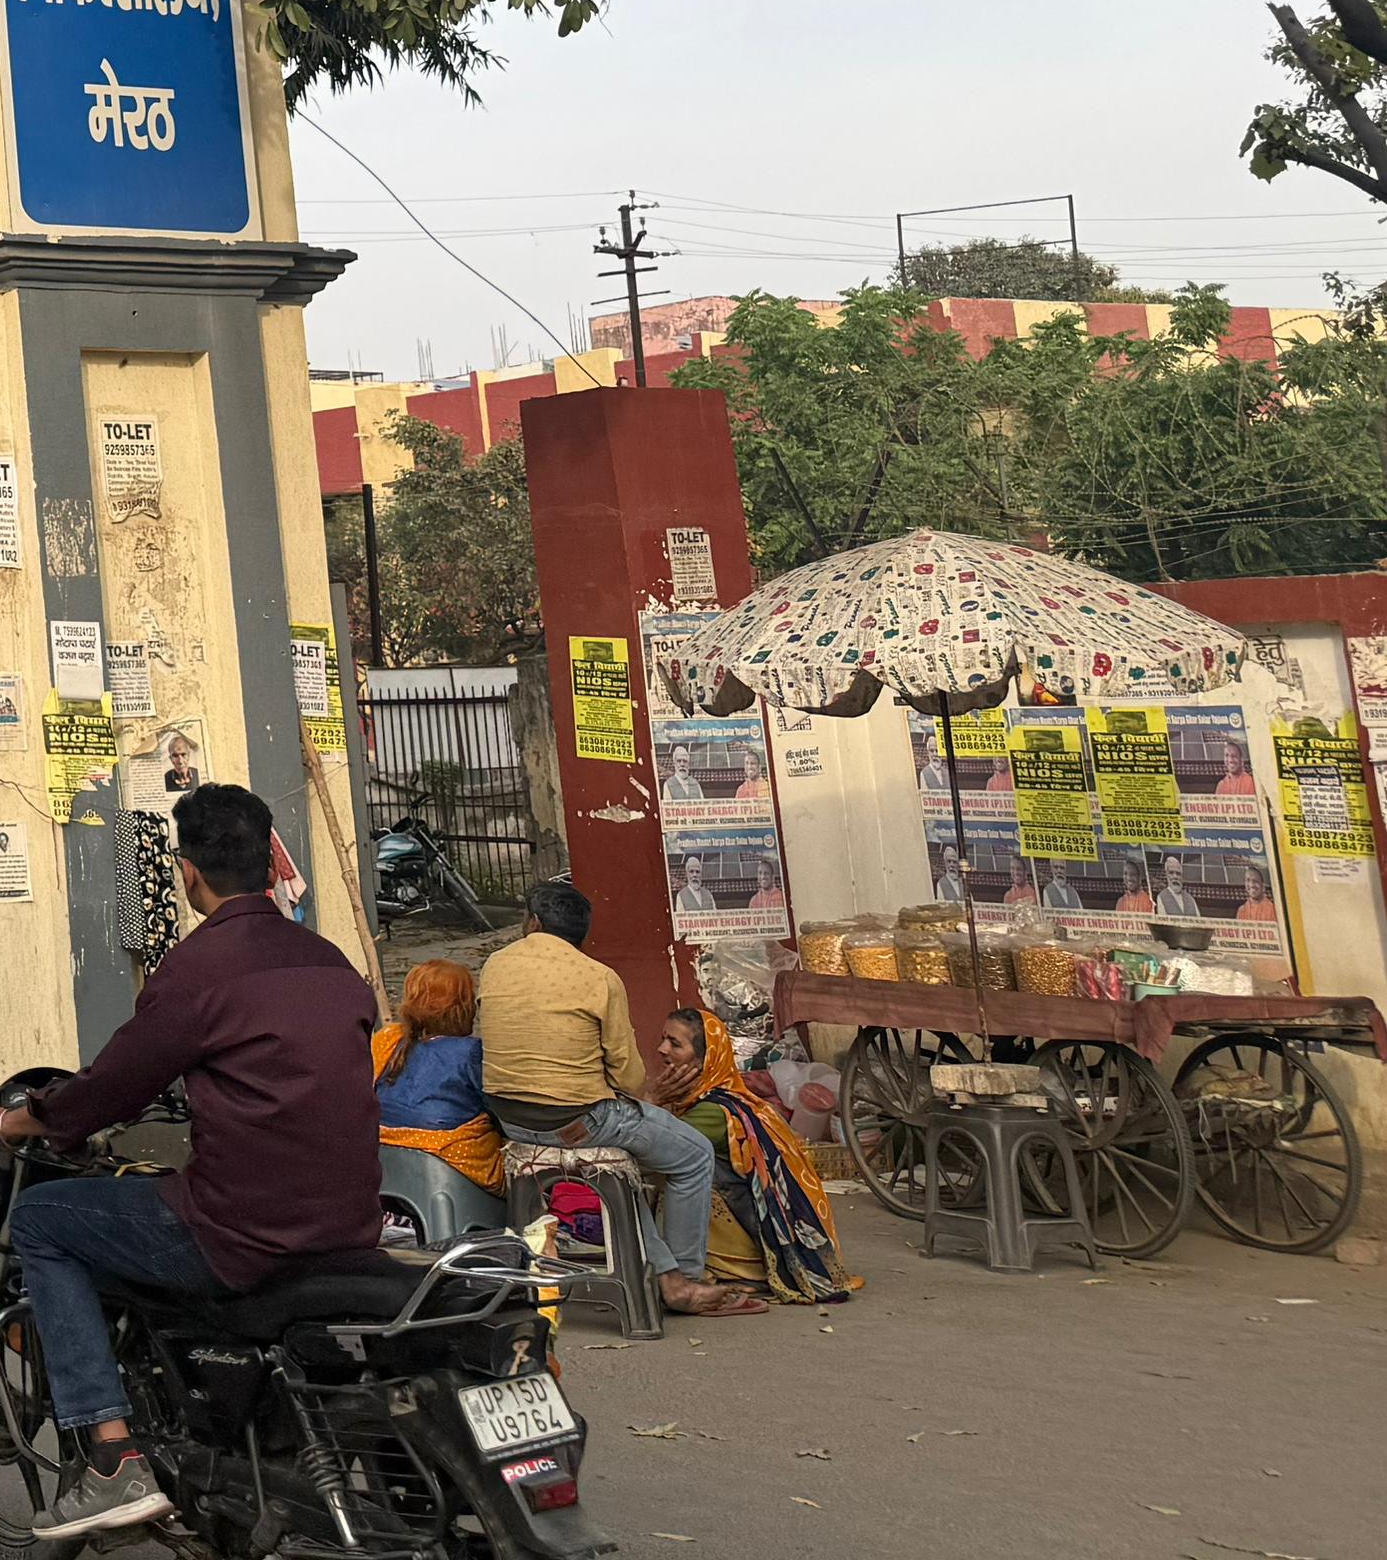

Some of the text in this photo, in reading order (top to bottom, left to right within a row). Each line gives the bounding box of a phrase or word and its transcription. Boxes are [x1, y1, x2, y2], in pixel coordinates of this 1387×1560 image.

[84, 58, 176, 152] मेरठ
[104, 423, 152, 440] TO-LET
[671, 531, 704, 544] TO-LET
[107, 645, 144, 657] TO-LET
[290, 645, 320, 657] O-LET
[576, 676, 612, 687] NIOS
[48, 732, 100, 743] NIOS
[941, 733, 1005, 742] 30872923
[941, 741, 1006, 750] 30869479
[1097, 751, 1148, 761] NIOS
[1280, 756, 1339, 767] NIOS
[1016, 768, 1064, 778] NIOS
[923, 797, 958, 808] STARW
[1185, 803, 1219, 813] ENERGY
[664, 806, 706, 817] STARWAY
[1106, 819, 1181, 829] 8630872923
[1107, 827, 1182, 839] 8630869479
[1288, 828, 1374, 843] 8630872923
[1025, 842, 1095, 854] 8630869479
[1289, 838, 1375, 852] 8630869479
[678, 917, 719, 929] STARWAY
[720, 916, 752, 927] ENERGY
[1087, 919, 1120, 930] ENERGY
[1258, 929, 1276, 940] LTD.
[489, 1404, 562, 1443] U9764
[501, 1458, 558, 1482] POLICE
